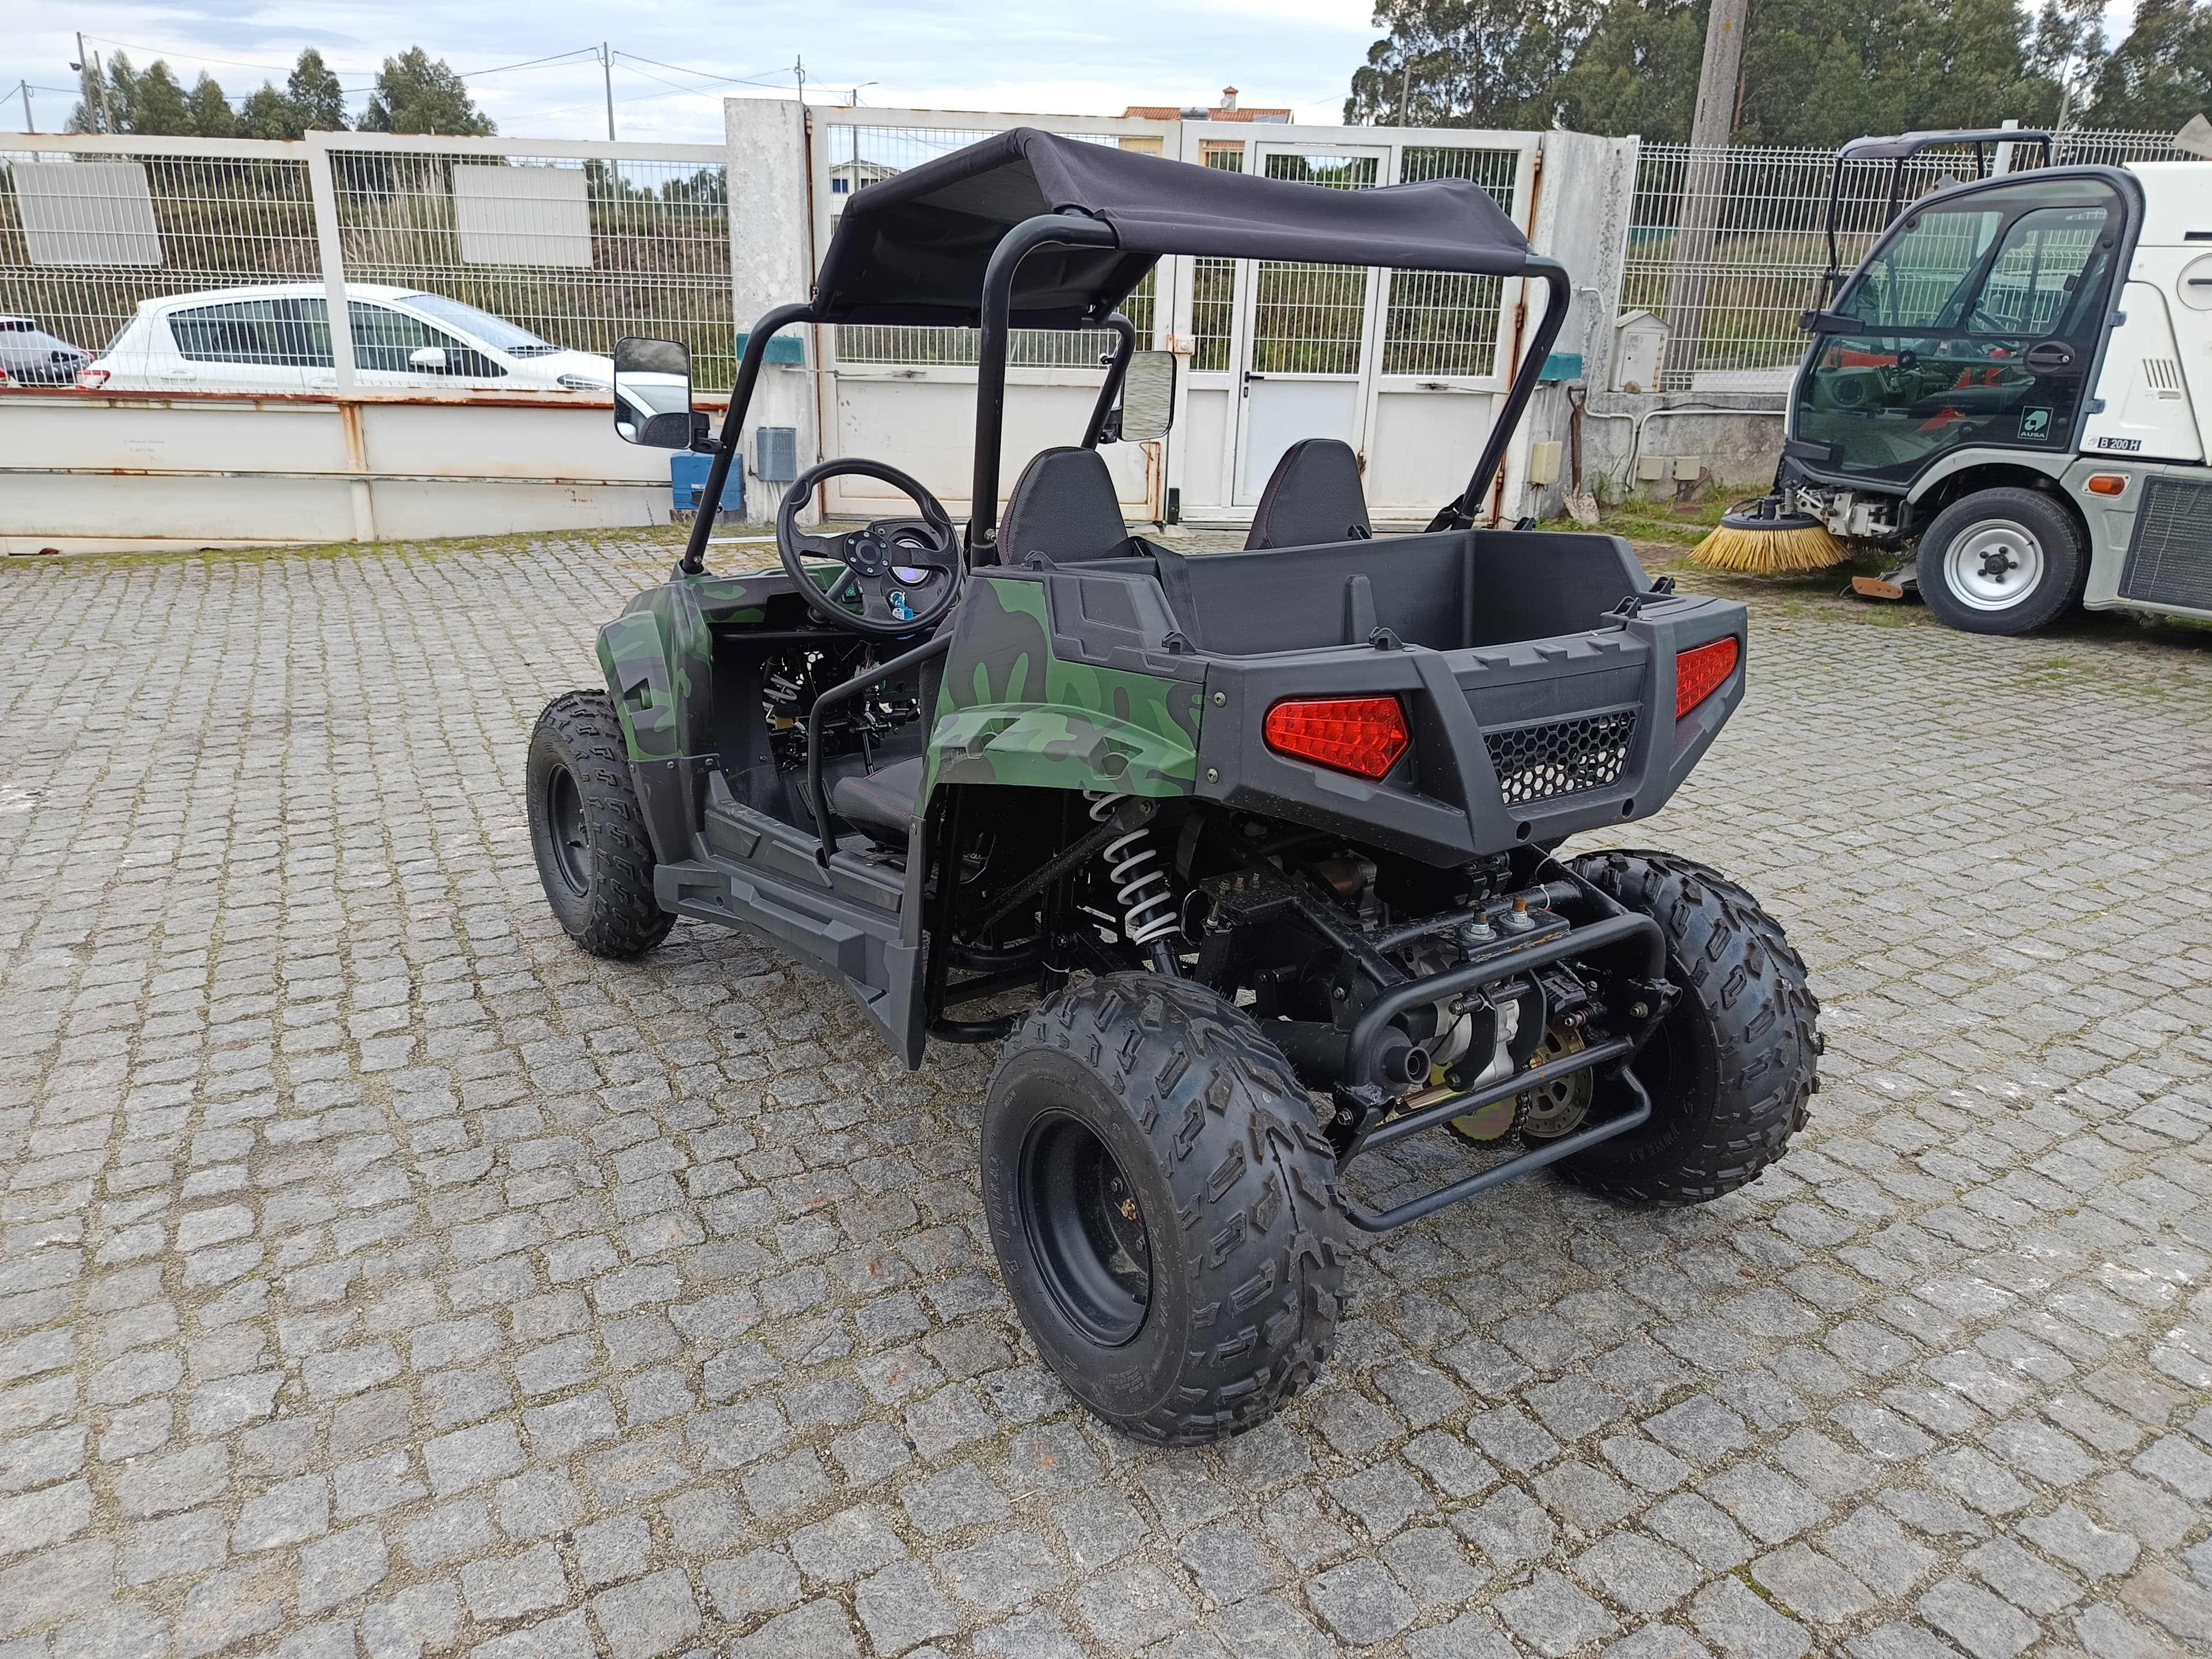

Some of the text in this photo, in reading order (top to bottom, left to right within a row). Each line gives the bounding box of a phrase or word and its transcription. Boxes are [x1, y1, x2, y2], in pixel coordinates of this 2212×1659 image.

[2100, 438, 2138, 450] B 200 H
